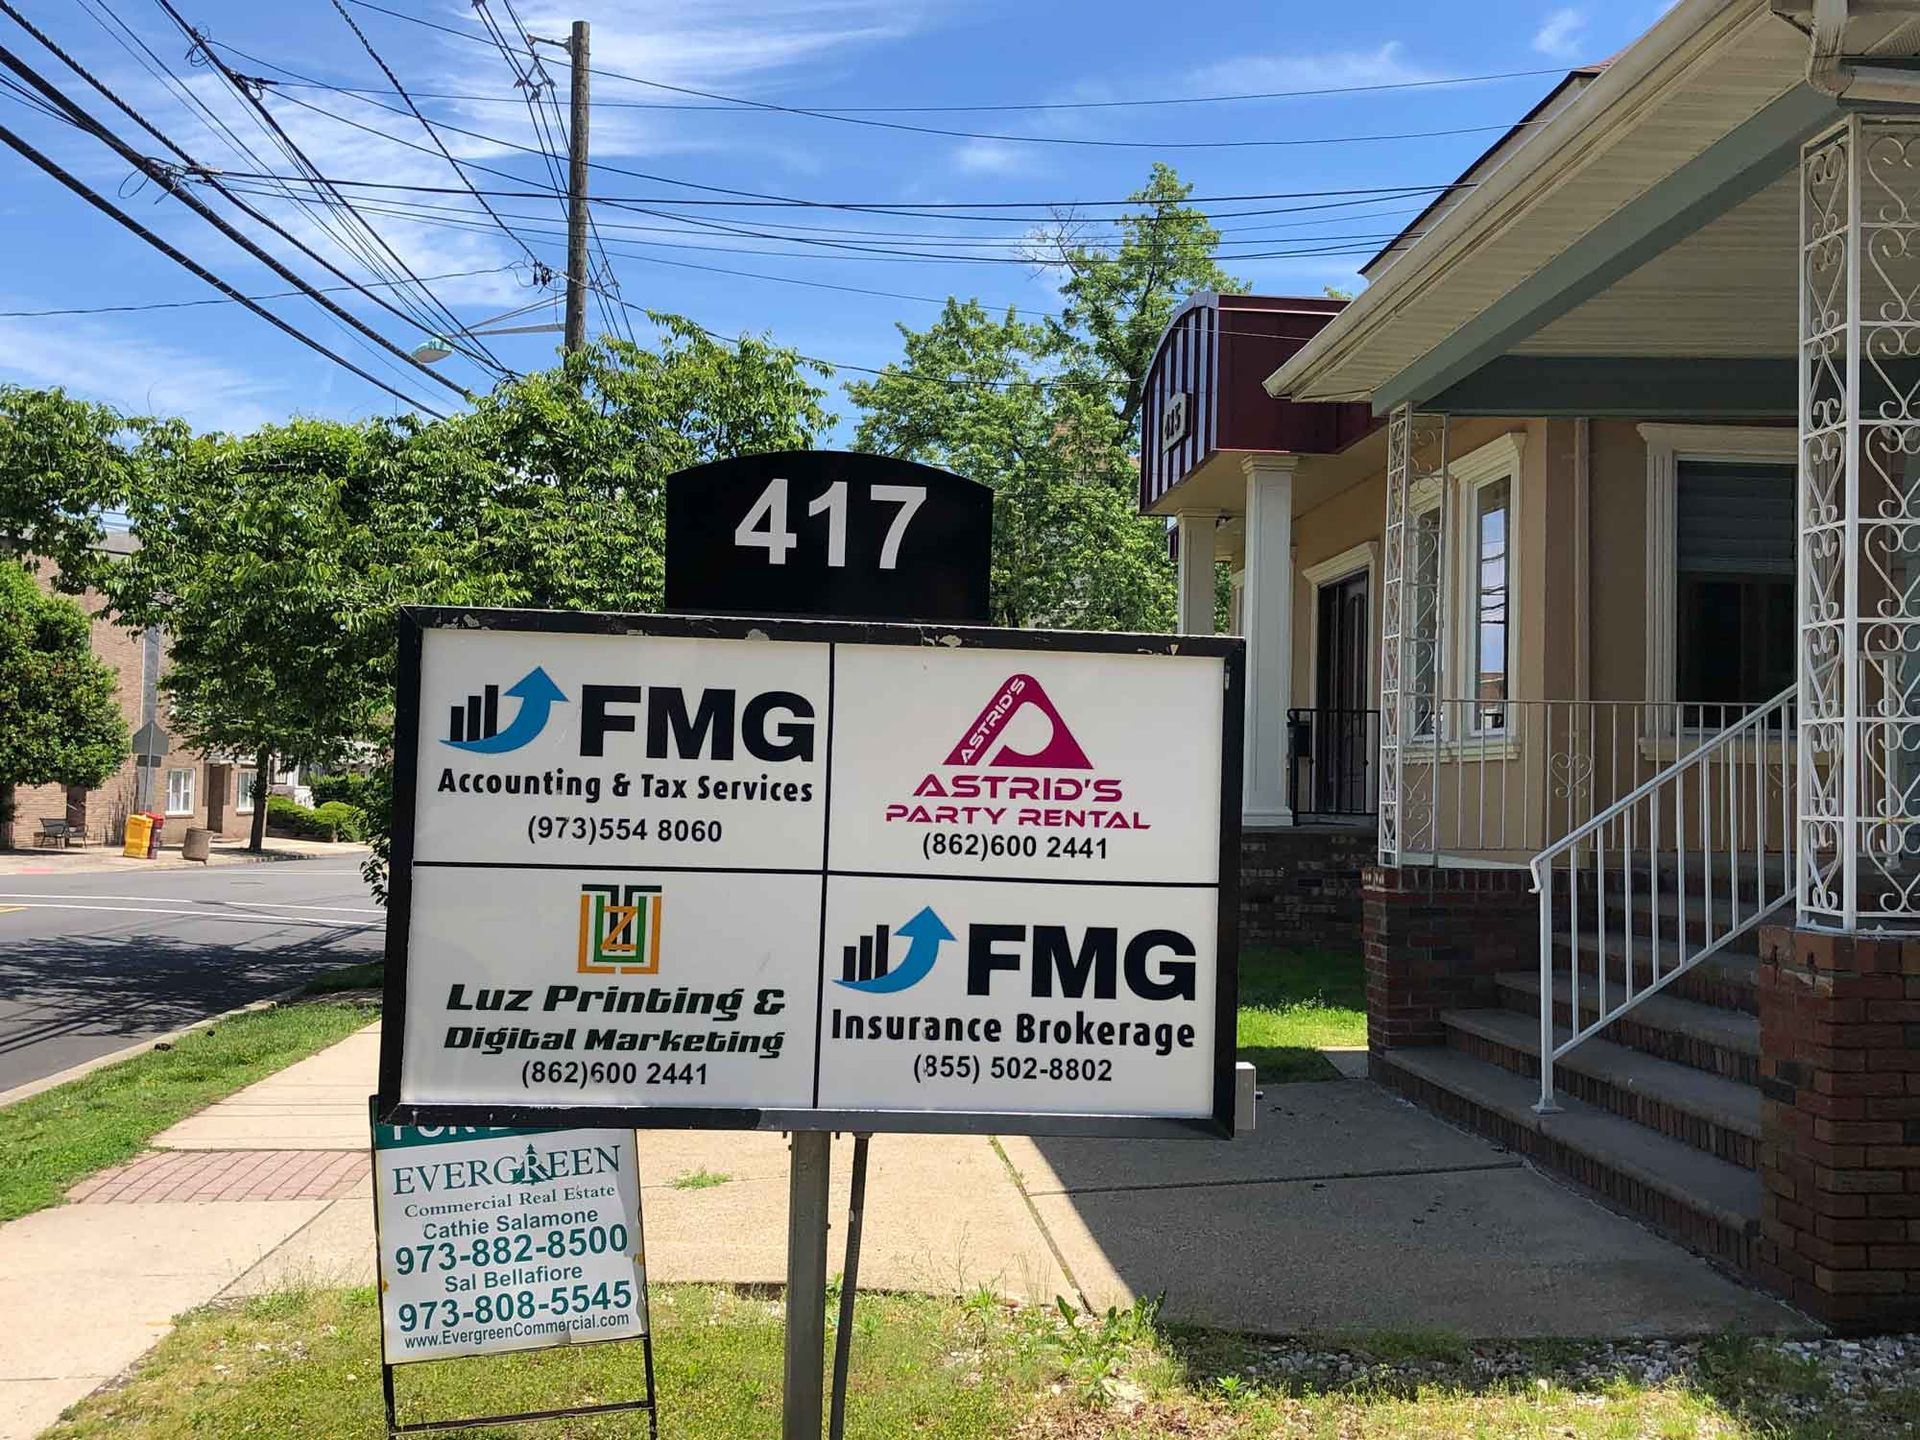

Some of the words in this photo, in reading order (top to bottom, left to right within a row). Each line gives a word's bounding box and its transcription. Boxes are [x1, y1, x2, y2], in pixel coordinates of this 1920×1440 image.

[734, 478, 928, 570] 417
[579, 684, 816, 763] FMG
[960, 678, 1026, 764] ASTRID'S
[437, 768, 601, 804] Accounting
[612, 773, 631, 797] &
[642, 773, 687, 799] Tax
[697, 774, 813, 802] Services
[912, 773, 1123, 803] ASTRID'S
[527, 815, 648, 845] (973)554
[658, 819, 723, 842] 8060
[885, 804, 1008, 824] PARTY
[1018, 808, 1151, 829] RENTAL
[923, 832, 1037, 862] (862)600
[1046, 836, 1108, 859] 2441
[966, 923, 1197, 1001] FMG
[446, 984, 534, 1012] Luz
[542, 985, 744, 1022] Printing
[753, 988, 785, 1016] &
[443, 1026, 575, 1055] Digital
[583, 1029, 785, 1059] Marketing
[831, 1008, 1002, 1043] Insurance
[1016, 1011, 1195, 1056] Brokerage
[521, 1059, 637, 1089] (862)600
[646, 1062, 708, 1085] 2441
[913, 1053, 980, 1084] (855)
[991, 1056, 1112, 1082] 502-8802
[392, 1143, 622, 1195] EVERGREEN
[404, 1194, 513, 1219] Commercial
[519, 1189, 557, 1205] Real
[564, 1184, 615, 1201] Estate
[423, 1218, 490, 1240] Cathie
[496, 1208, 599, 1233] Salamone
[395, 1223, 628, 1276] 973-882-8500
[444, 1273, 477, 1293] Sal
[484, 1265, 583, 1289] Bellafiore
[398, 1279, 632, 1333] 973-808-5545
[404, 1311, 630, 1349] www.EvergreenCommercial.com
